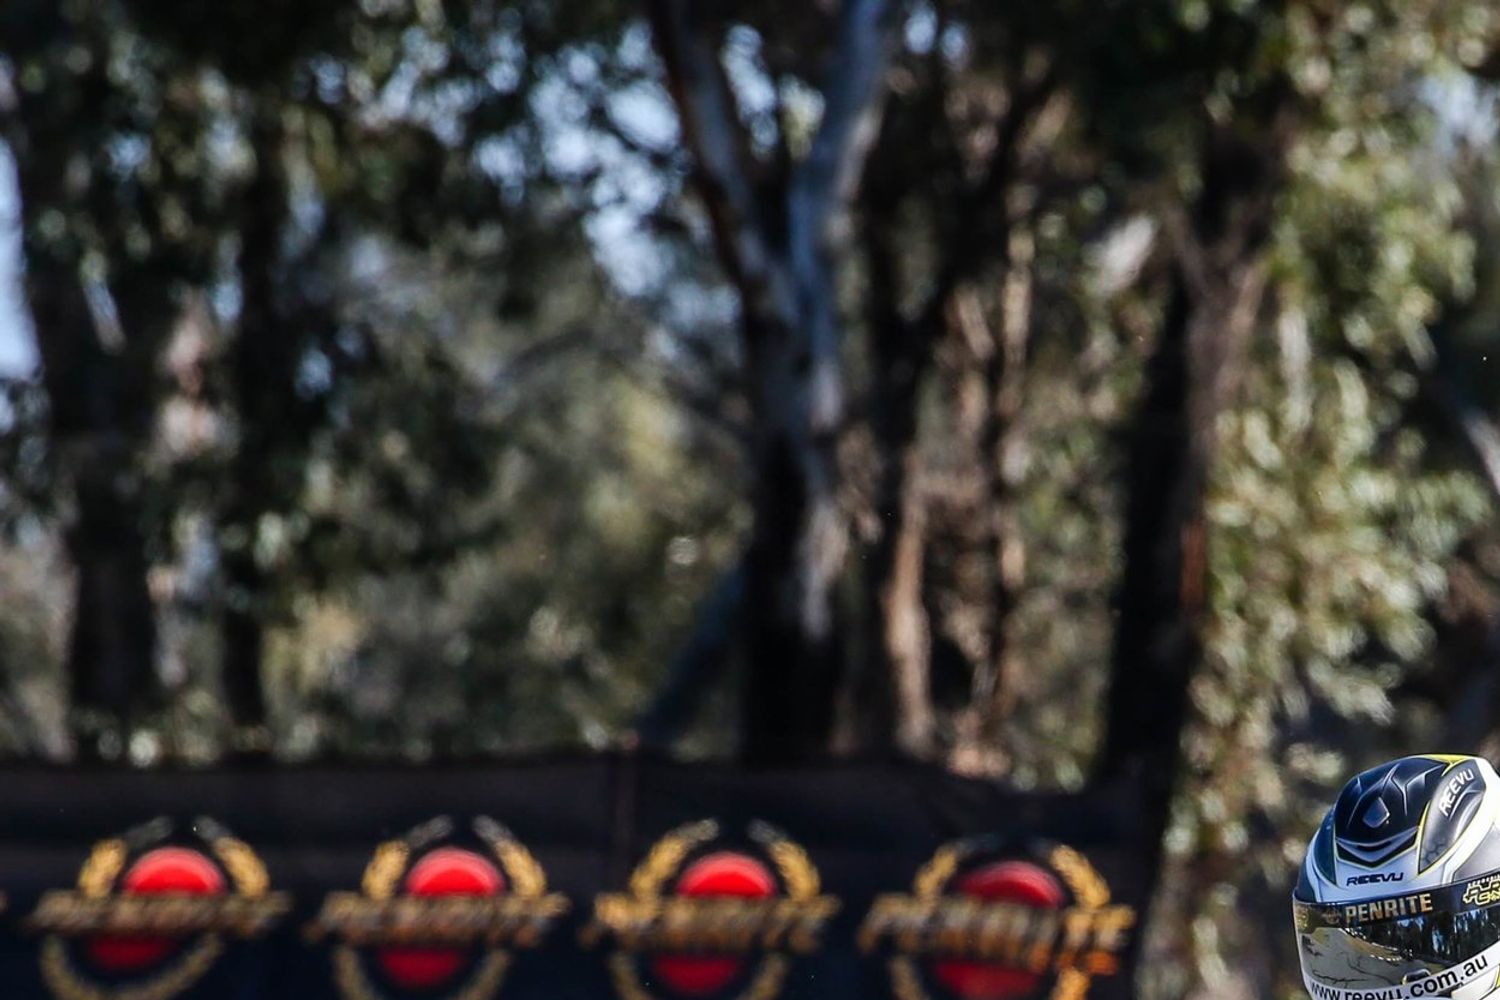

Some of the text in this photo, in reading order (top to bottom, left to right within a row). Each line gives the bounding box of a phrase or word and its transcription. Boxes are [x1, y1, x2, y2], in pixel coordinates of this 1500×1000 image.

[1438, 768, 1475, 817] REEVU
[1346, 872, 1404, 887] REEVU
[1345, 892, 1434, 923] PENRITE
